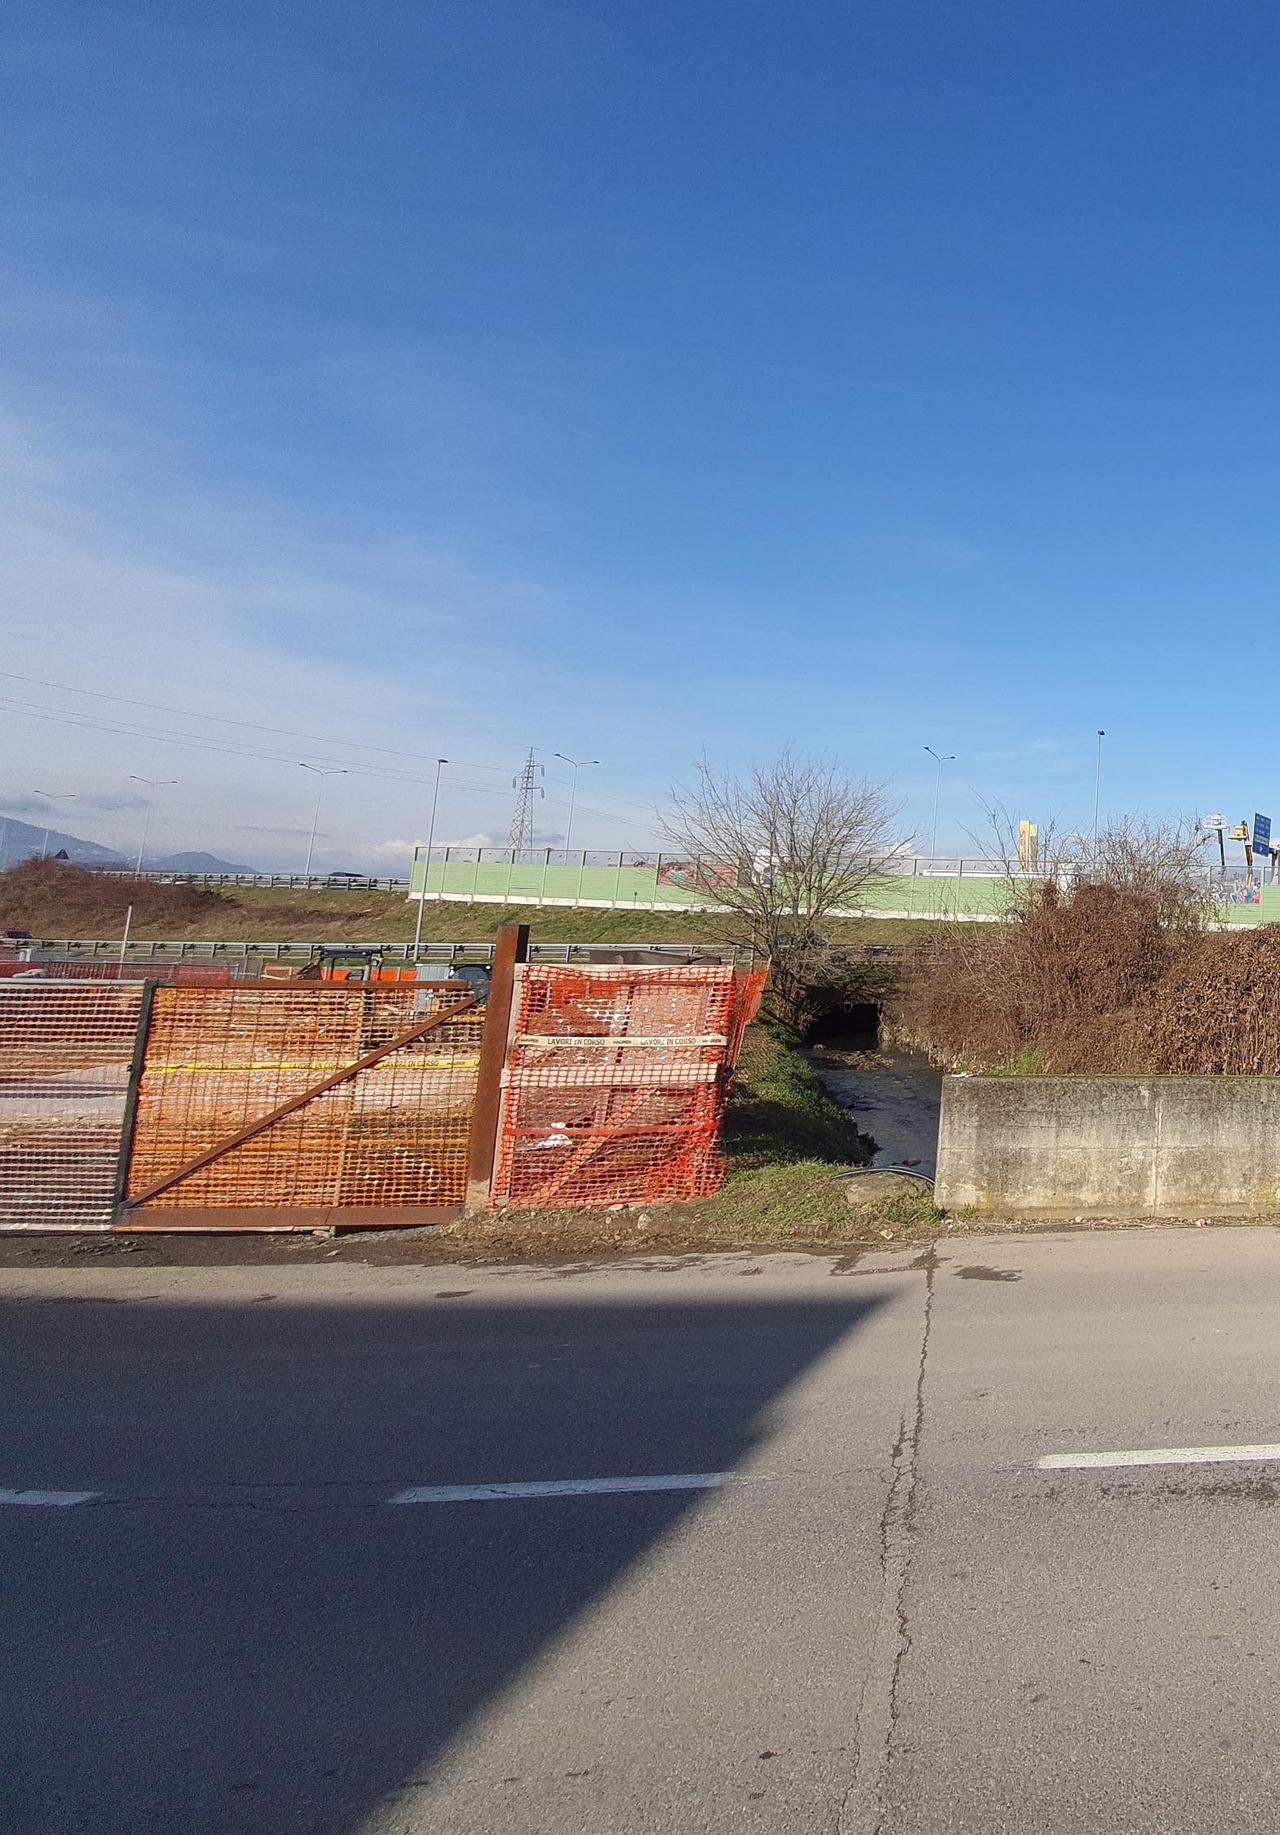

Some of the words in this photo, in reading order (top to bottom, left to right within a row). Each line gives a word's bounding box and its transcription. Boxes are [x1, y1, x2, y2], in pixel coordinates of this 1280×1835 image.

[547, 1037, 572, 1045] LAVORI
[583, 1038, 606, 1046] CORSO
[675, 1037, 697, 1045] CORSO
